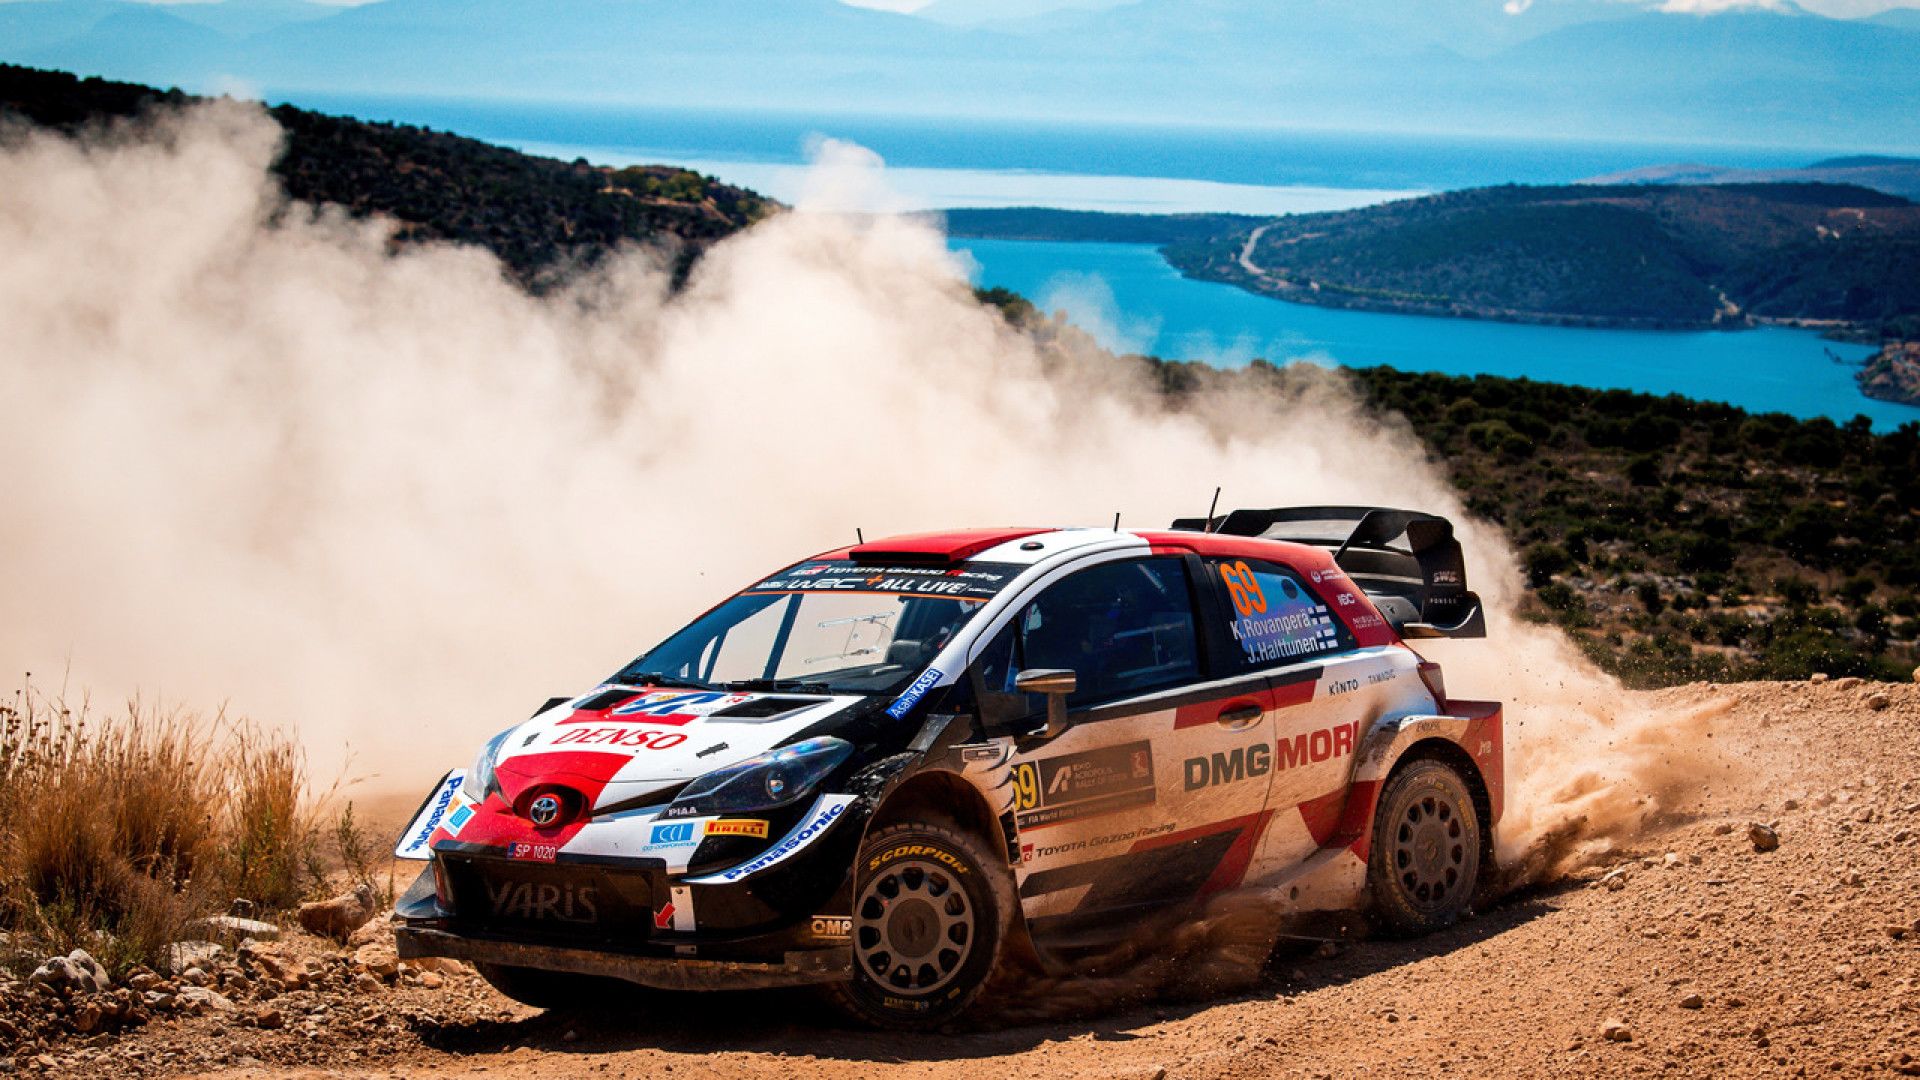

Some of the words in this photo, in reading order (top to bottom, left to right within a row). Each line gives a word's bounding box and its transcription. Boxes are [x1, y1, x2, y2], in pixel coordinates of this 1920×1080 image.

[875, 579, 915, 590] ALL
[917, 580, 966, 593] LIVE
[1220, 560, 1267, 617] 69
[1230, 608, 1312, 640] K.Rovanperä
[1248, 636, 1320, 663] J.Halttunen
[550, 728, 688, 750] DENSO
[1184, 743, 1270, 792] DMG
[405, 775, 464, 852] Panasonic
[668, 807, 697, 816] PIAA
[707, 822, 764, 835] PIRELLI
[723, 803, 845, 880] Panasonic
[515, 844, 530, 857] SP
[534, 845, 556, 860] 1020
[1036, 841, 1087, 857] TOYOTA
[1089, 831, 1137, 847] GAZOO
[869, 845, 969, 874] SCORPION
[811, 920, 852, 934] OMP
